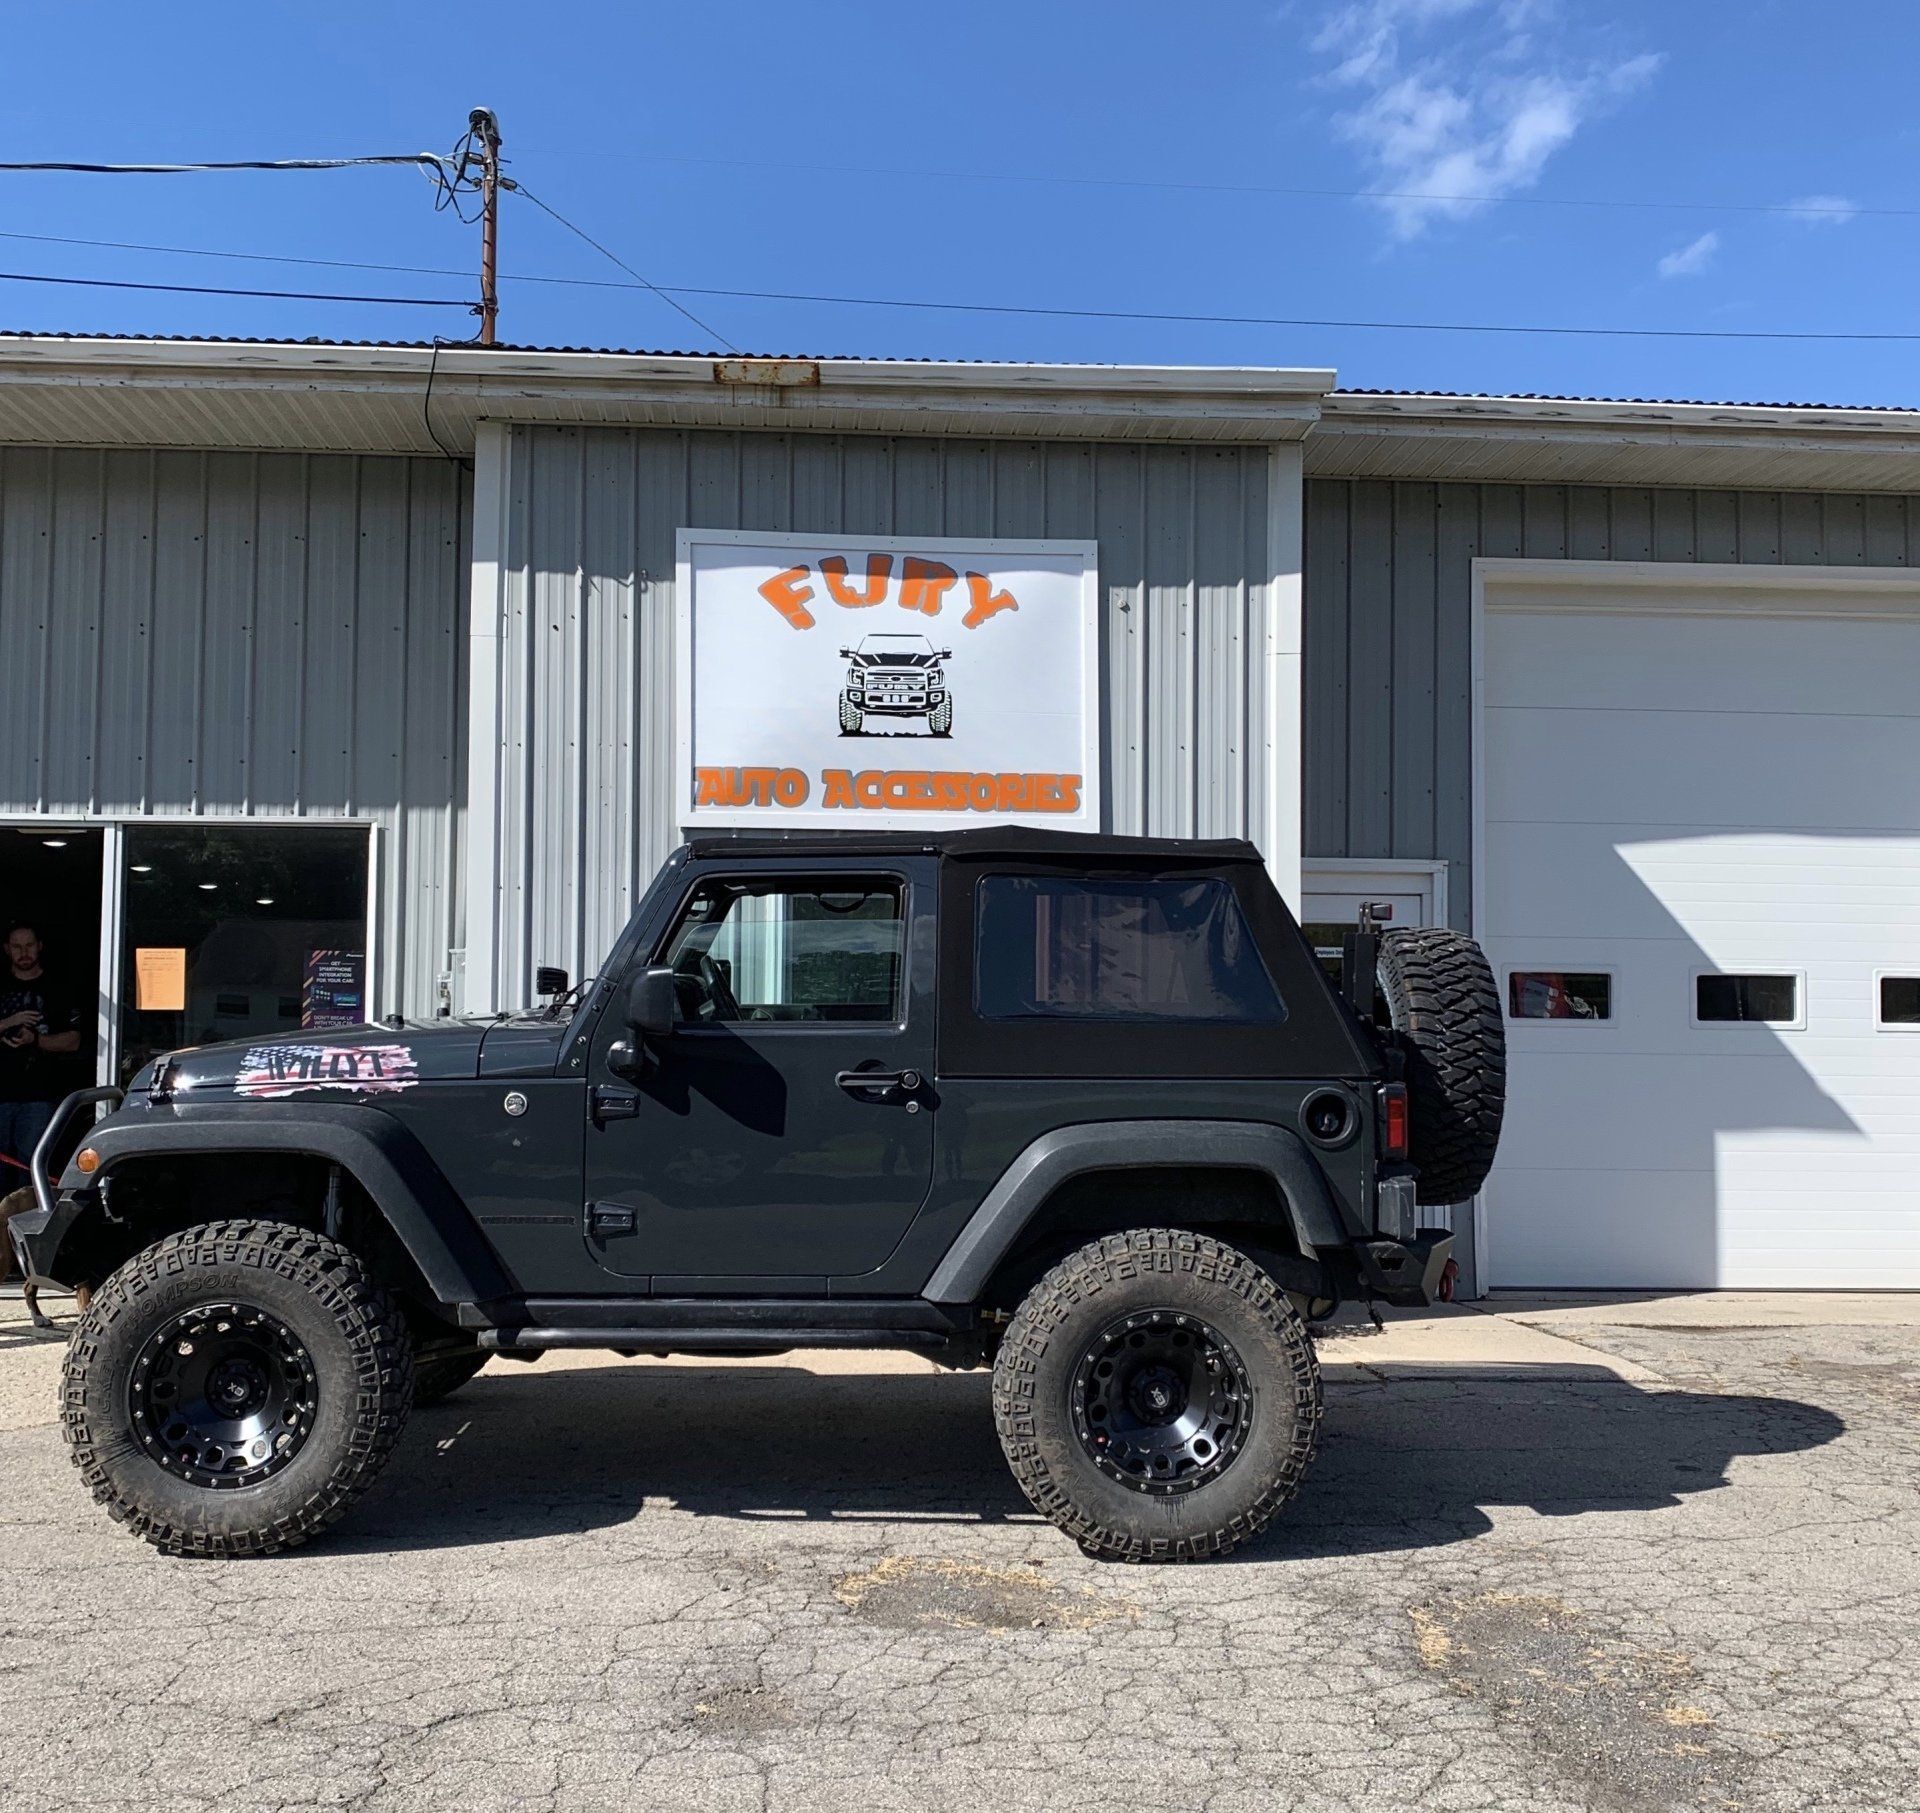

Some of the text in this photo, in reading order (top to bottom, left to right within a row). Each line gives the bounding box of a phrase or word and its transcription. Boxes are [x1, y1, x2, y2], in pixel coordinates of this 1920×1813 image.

[758, 553, 1019, 630] FURY
[693, 766, 1082, 813] AUTO ACCESSORIES
[117, 1274, 239, 1337] THOMPSON
